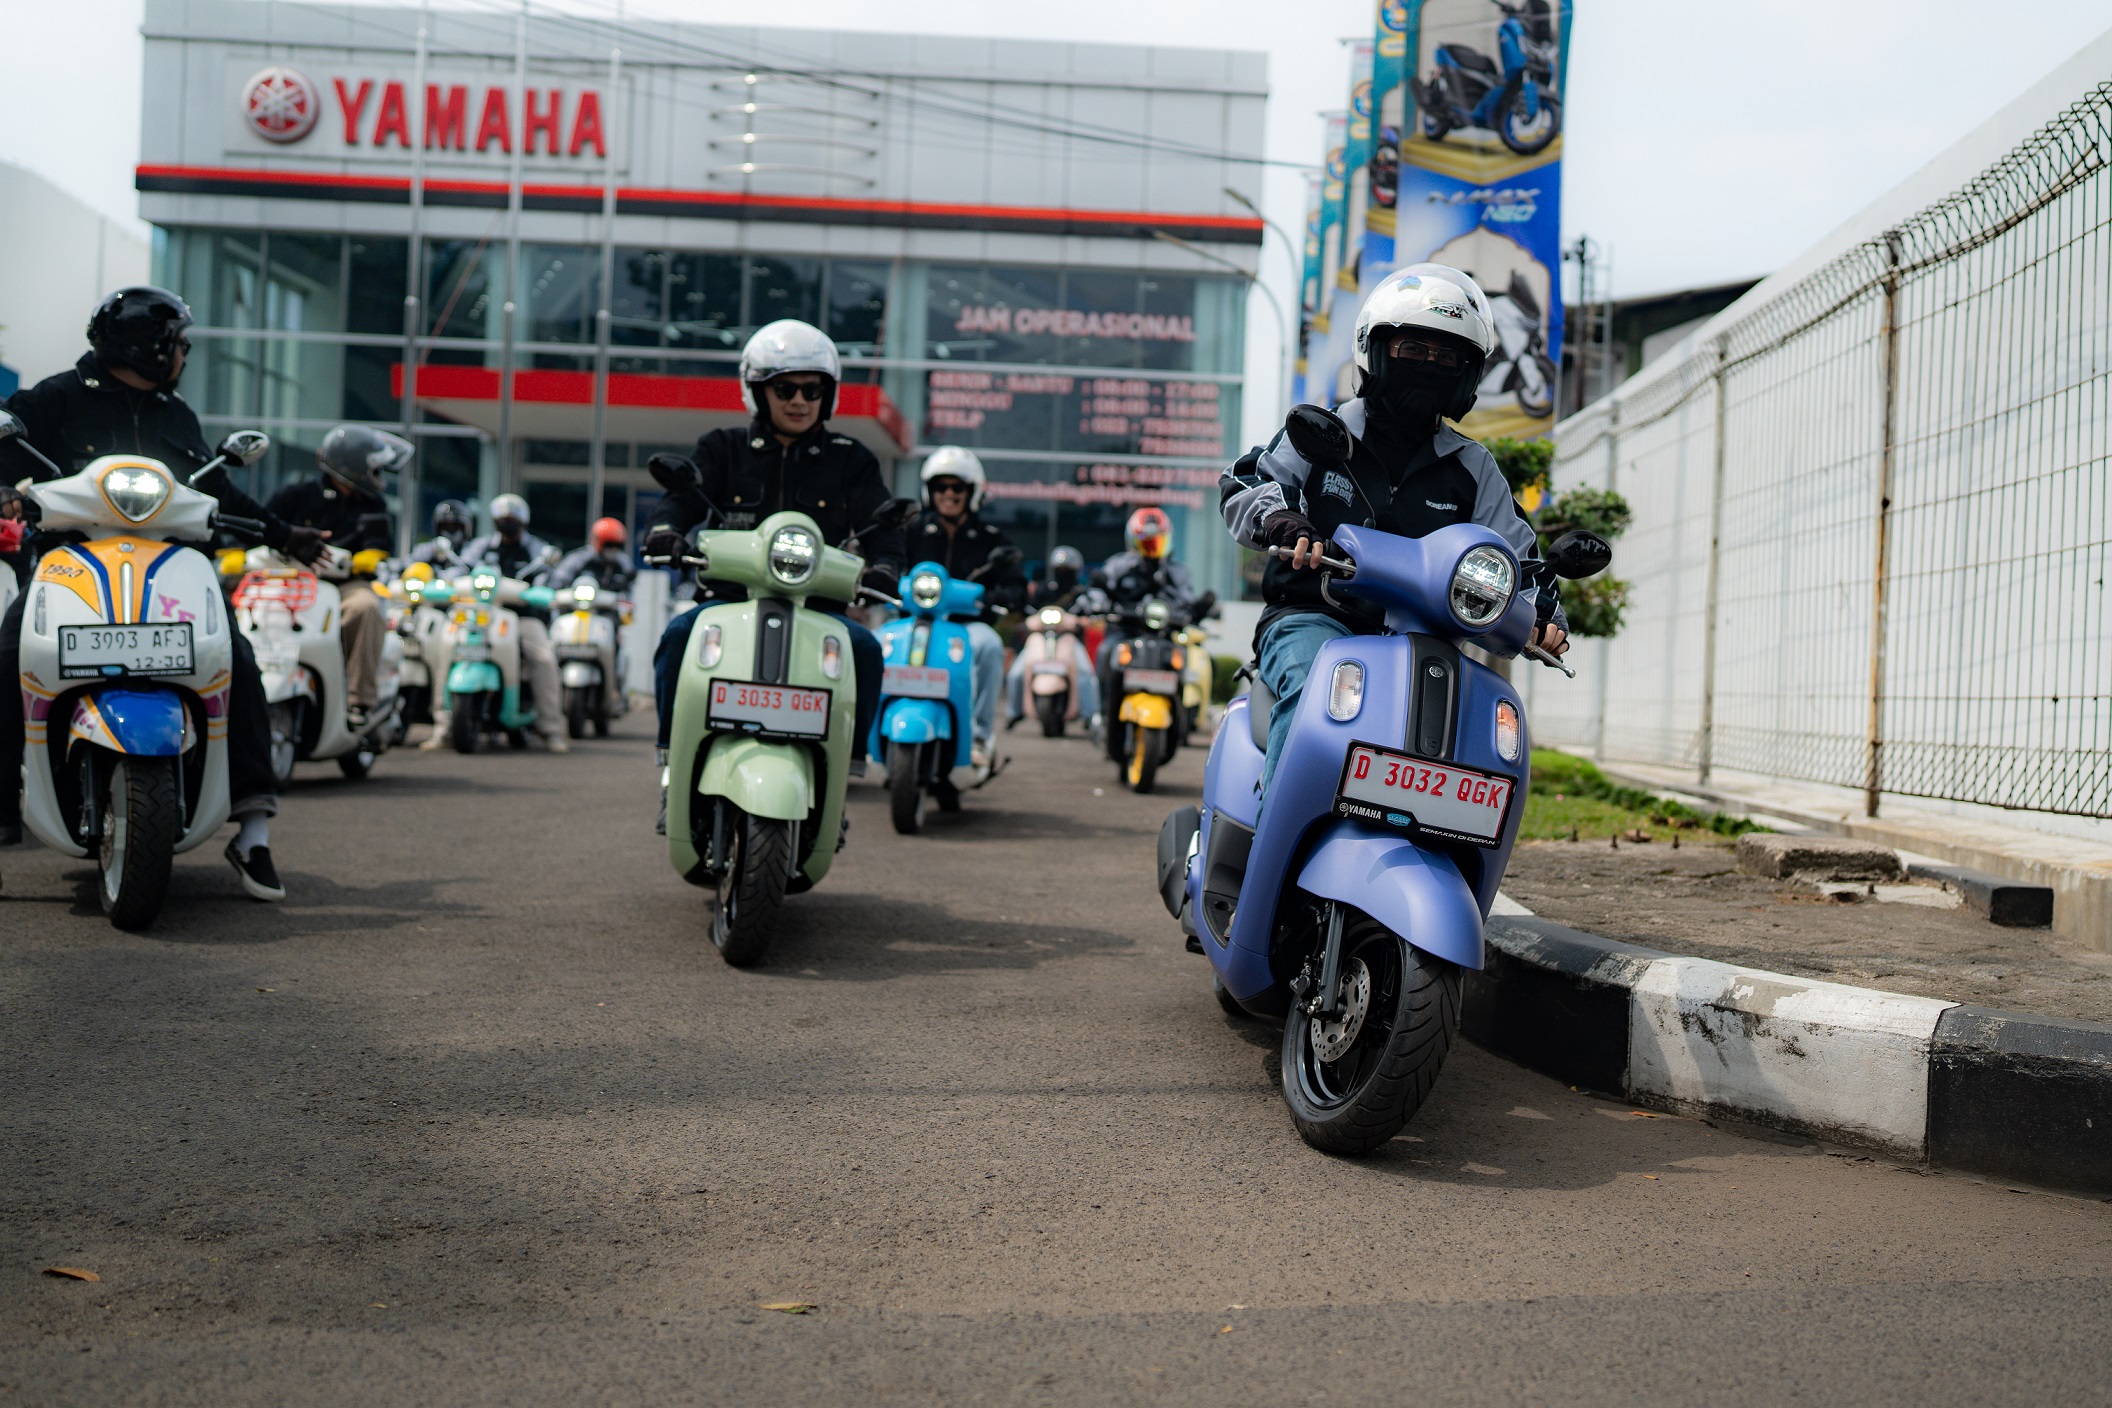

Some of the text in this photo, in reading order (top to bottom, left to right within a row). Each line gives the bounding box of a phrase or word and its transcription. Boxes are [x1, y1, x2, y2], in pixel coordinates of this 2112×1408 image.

[331, 77, 607, 158] YAMAHA
[956, 306, 1198, 342] JAM OPERASIONAL
[1324, 472, 1354, 492] CLASSY
[1322, 484, 1354, 503] FUN DAY
[67, 629, 187, 651] D 3993 AFJ
[716, 686, 823, 712] D 3033 QGK
[1354, 754, 1504, 809] D 3032 QGK
[1349, 804, 1382, 820] YAMAHA
[1419, 827, 1457, 839] SEMAKIN
[1466, 836, 1496, 845] DEPAN
